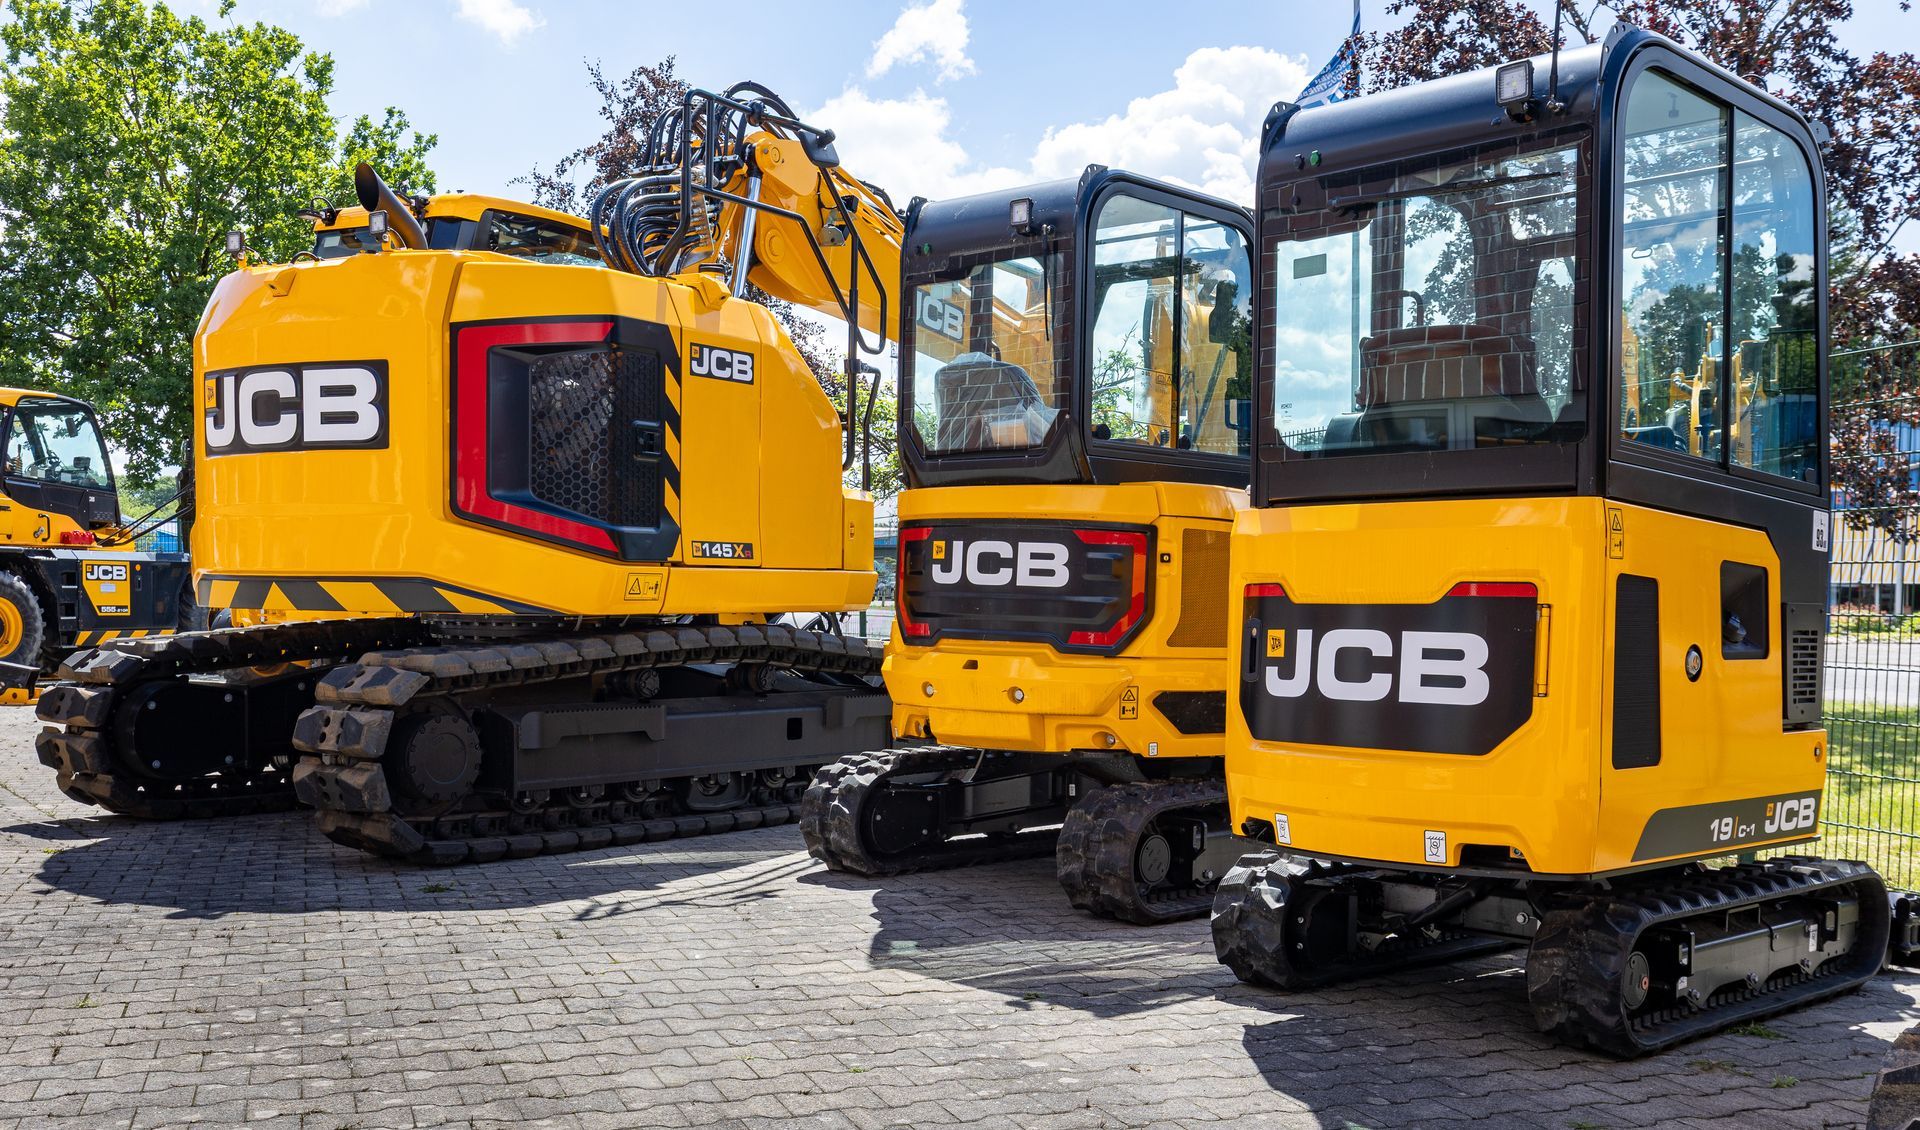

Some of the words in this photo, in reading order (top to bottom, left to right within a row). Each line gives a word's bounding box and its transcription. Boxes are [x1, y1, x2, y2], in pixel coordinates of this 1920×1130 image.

[691, 347, 753, 382] JCB
[205, 368, 380, 447] JCB
[86, 565, 127, 580] JCB
[932, 540, 1070, 588] JCB
[1265, 628, 1490, 706] JCB
[1764, 797, 1816, 834] JCB
